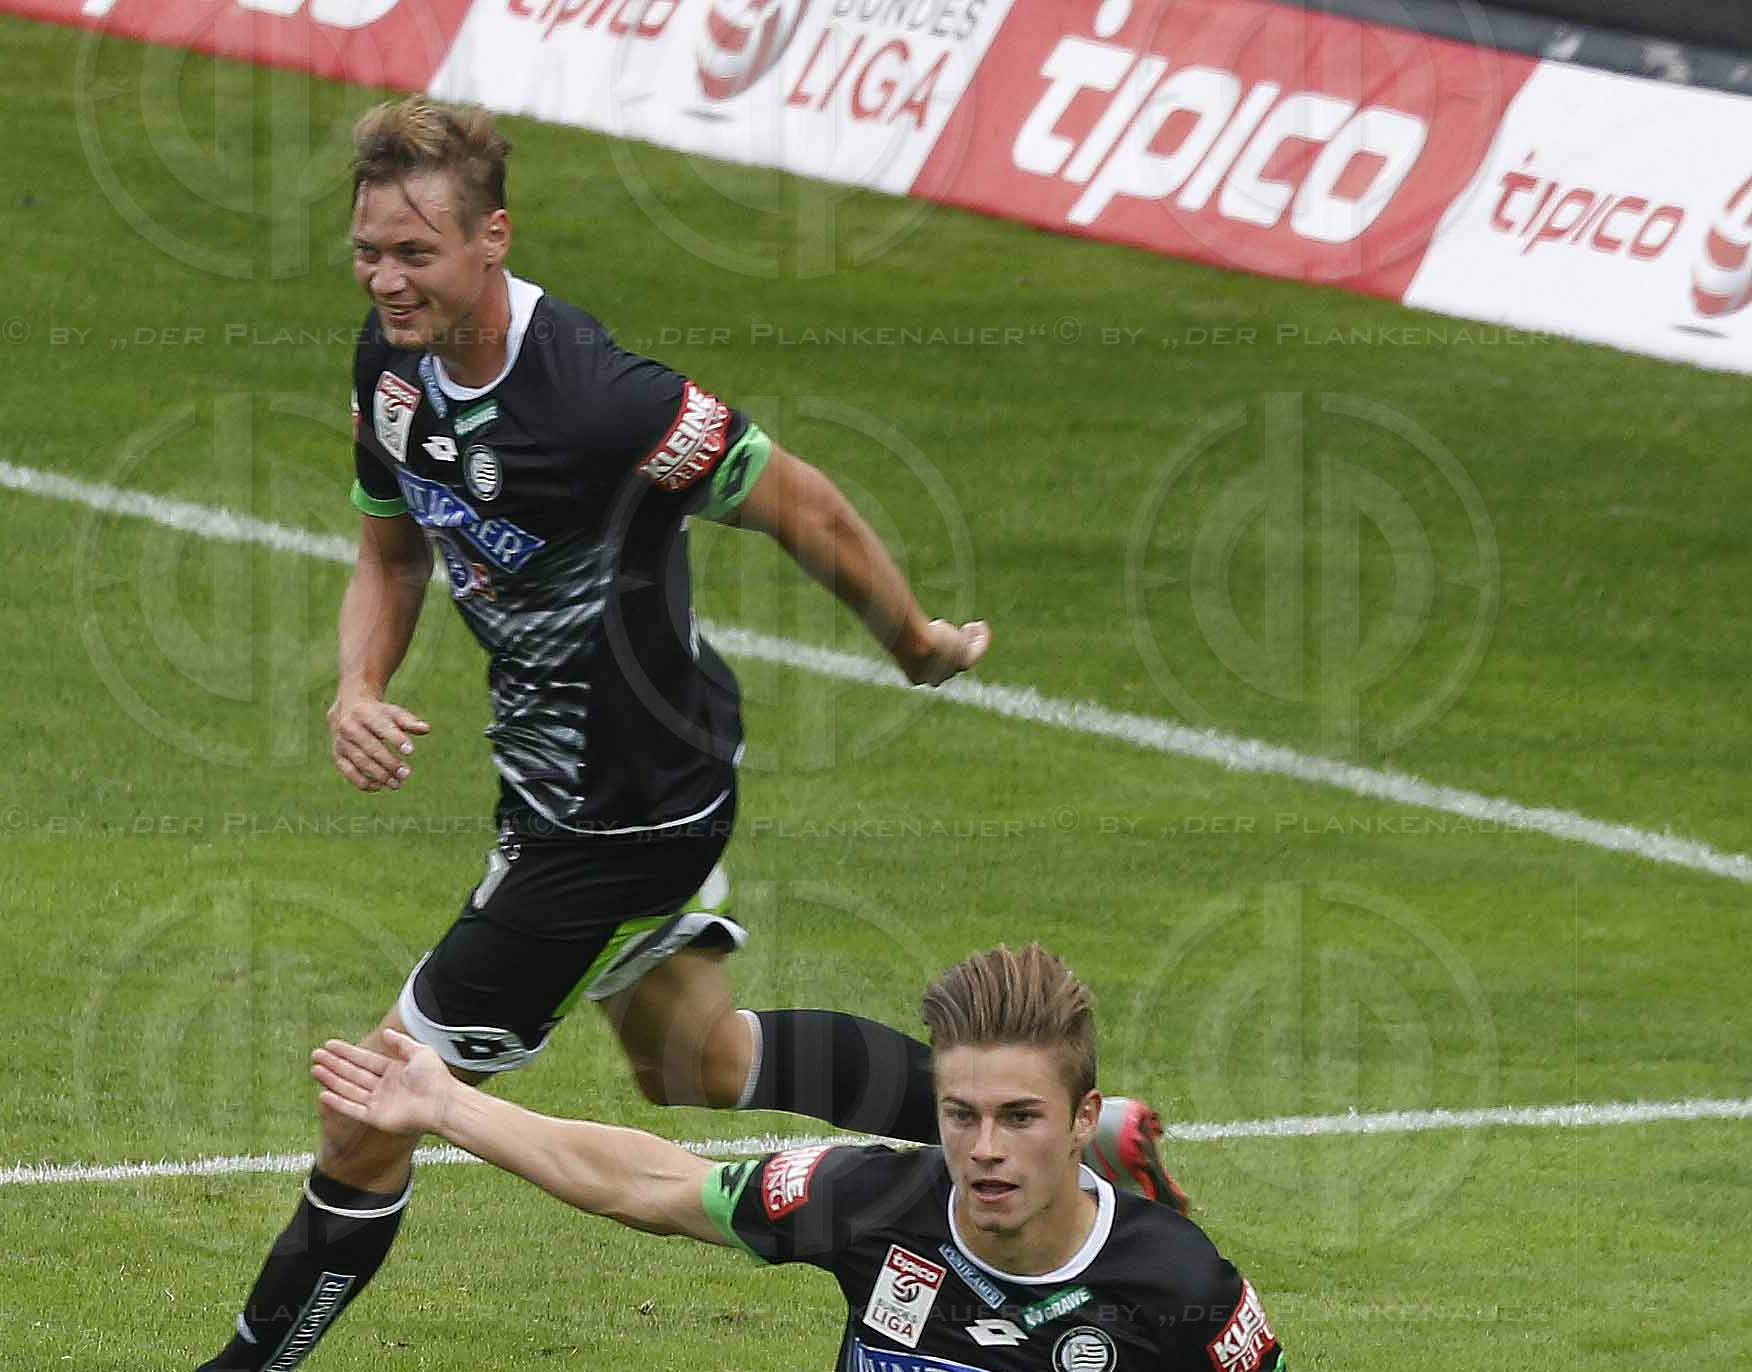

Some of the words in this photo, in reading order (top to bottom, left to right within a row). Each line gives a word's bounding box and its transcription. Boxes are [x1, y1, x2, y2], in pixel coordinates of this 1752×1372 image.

[785, 27, 951, 130] LIGA
[1012, 0, 1429, 244] tipico
[1492, 150, 1685, 260] tipico
[872, 1306, 913, 1338] LIGA
